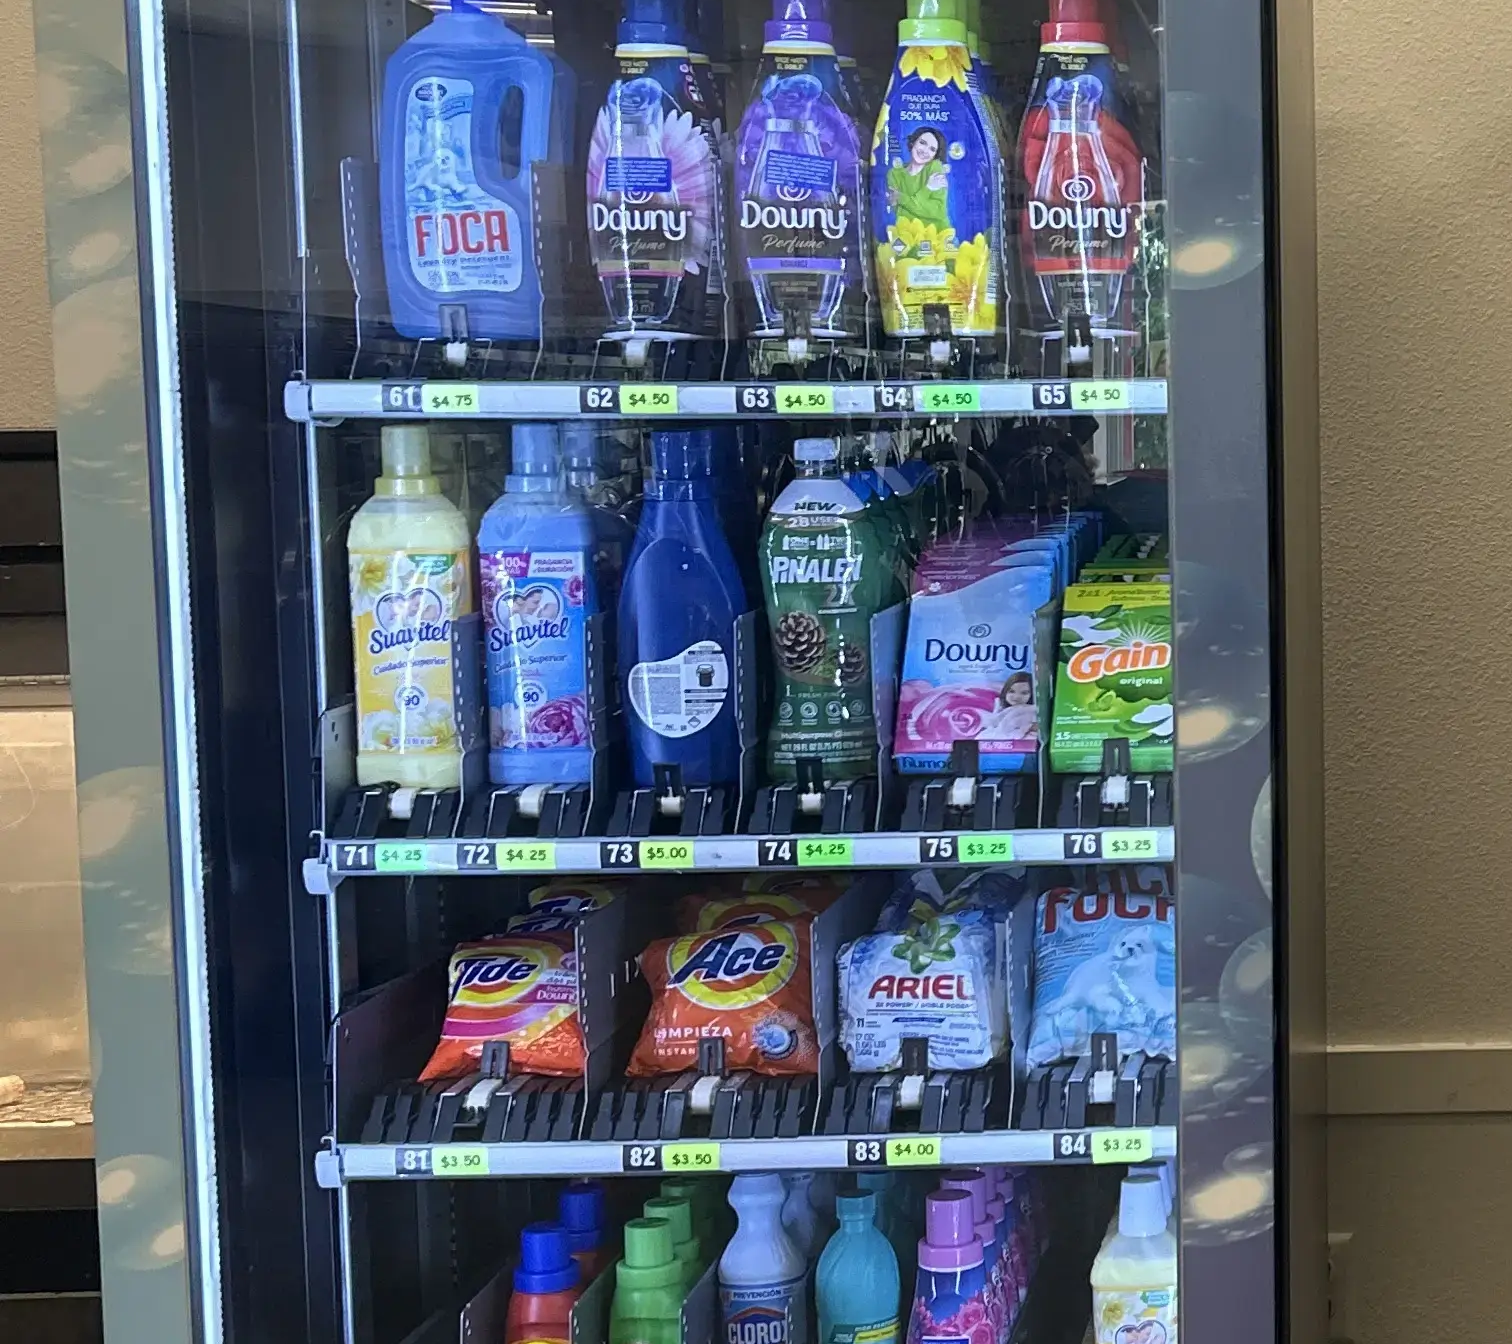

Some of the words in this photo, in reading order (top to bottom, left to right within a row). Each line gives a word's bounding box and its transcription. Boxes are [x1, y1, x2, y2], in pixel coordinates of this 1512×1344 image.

[741, 200, 850, 239] Downy
[389, 387, 415, 408] 61
[586, 387, 613, 408] 62
[629, 392, 670, 407] $4.50
[743, 387, 770, 408] 63
[784, 393, 825, 408] $4.50
[880, 387, 907, 408] 64
[932, 392, 973, 406] $4.50
[1039, 385, 1066, 406] 65
[1080, 389, 1121, 404] $4.50
[794, 502, 836, 511] NEW
[788, 517, 810, 528] 28
[925, 638, 1029, 670] Downy
[1067, 640, 1172, 684] Gain
[1120, 677, 1164, 688] original
[607, 844, 634, 864] 73
[646, 846, 688, 860] $5.00
[765, 841, 792, 861] 74
[804, 843, 846, 857] $4.25
[926, 838, 953, 858] 75
[967, 843, 1007, 856] $3.25
[1070, 834, 1096, 854] 76
[1112, 839, 1151, 852] $3.25
[344, 846, 368, 866] 71
[463, 845, 490, 866] 72
[506, 849, 547, 862] $4.25
[667, 931, 788, 989] Ace
[450, 956, 538, 1001] Tide
[868, 974, 968, 1000] ARIEL
[854, 1142, 880, 1162] 83
[894, 1143, 934, 1157] $4.00
[1060, 1135, 1086, 1155] 84
[1103, 1138, 1142, 1152] $3.25
[403, 1150, 429, 1171] 81
[441, 1155, 481, 1168] $3.50
[629, 1146, 656, 1167] 82
[672, 1153, 713, 1166] $3.50
